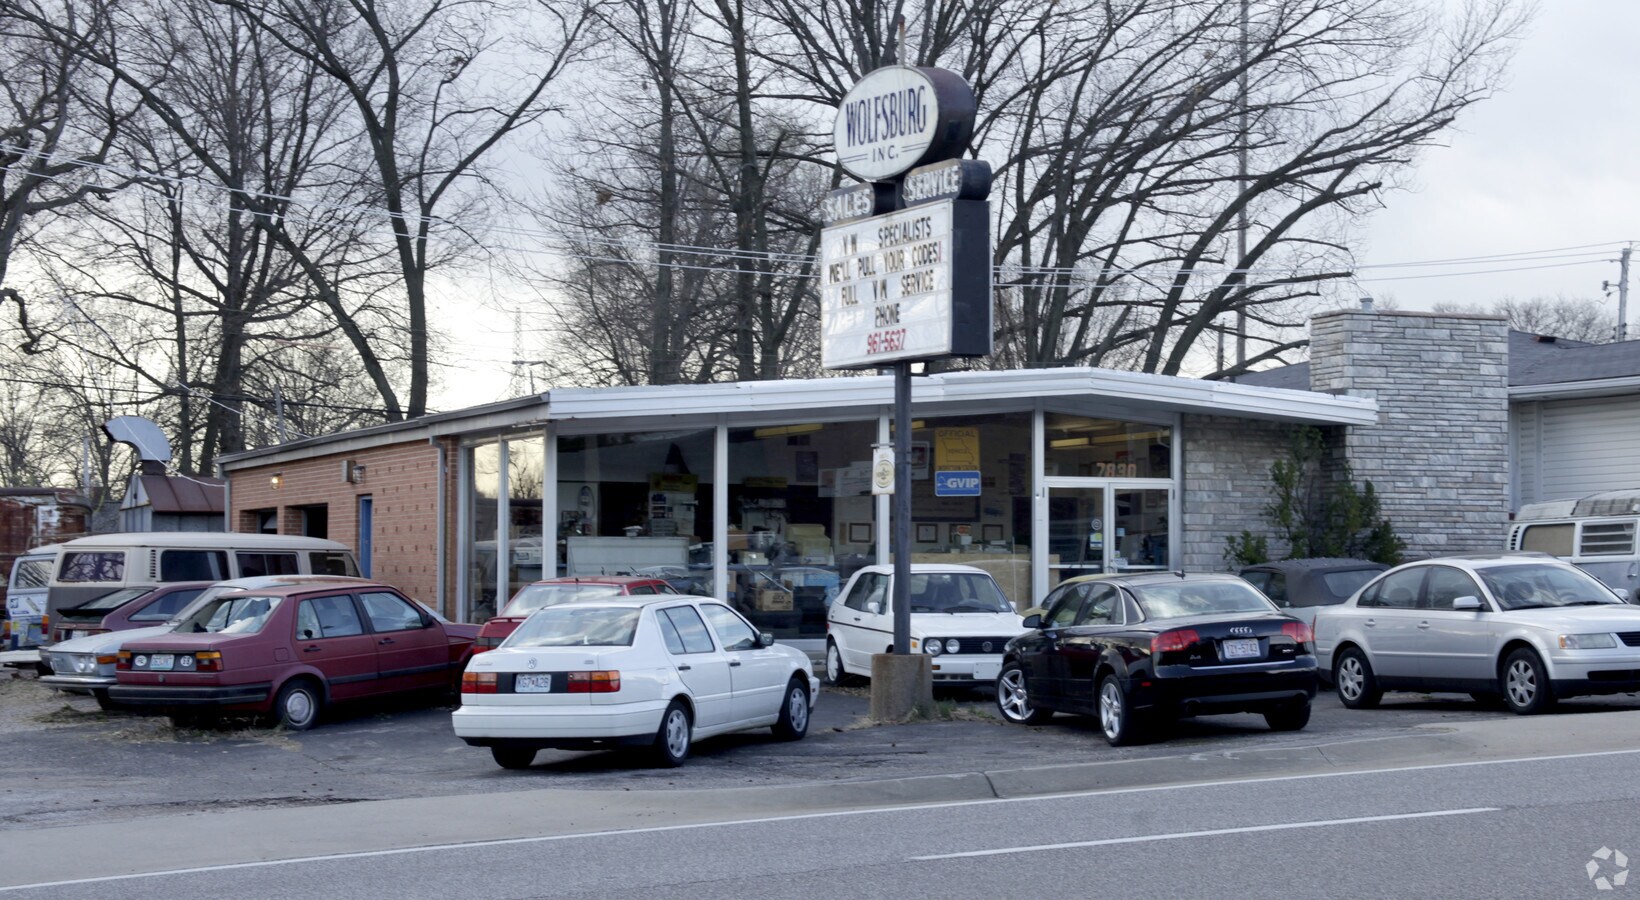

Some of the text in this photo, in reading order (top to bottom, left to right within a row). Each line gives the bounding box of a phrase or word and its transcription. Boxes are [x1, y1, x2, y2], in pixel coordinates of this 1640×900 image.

[845, 85, 927, 148] WOLFSBURG
[872, 145, 899, 162] INC.
[905, 165, 960, 201] SERVICE
[822, 188, 872, 222] SALES
[878, 216, 932, 249] SPECIALISTS
[857, 255, 876, 277] PULL
[883, 249, 905, 272] YOUR
[841, 285, 858, 309] FULL
[901, 269, 934, 297] SERVICE
[875, 303, 900, 328] PHONE
[867, 328, 906, 354] 961-5637
[938, 430, 977, 438] OFFICIAL
[947, 478, 979, 489] GVIP
[1096, 462, 1137, 478] 7830
